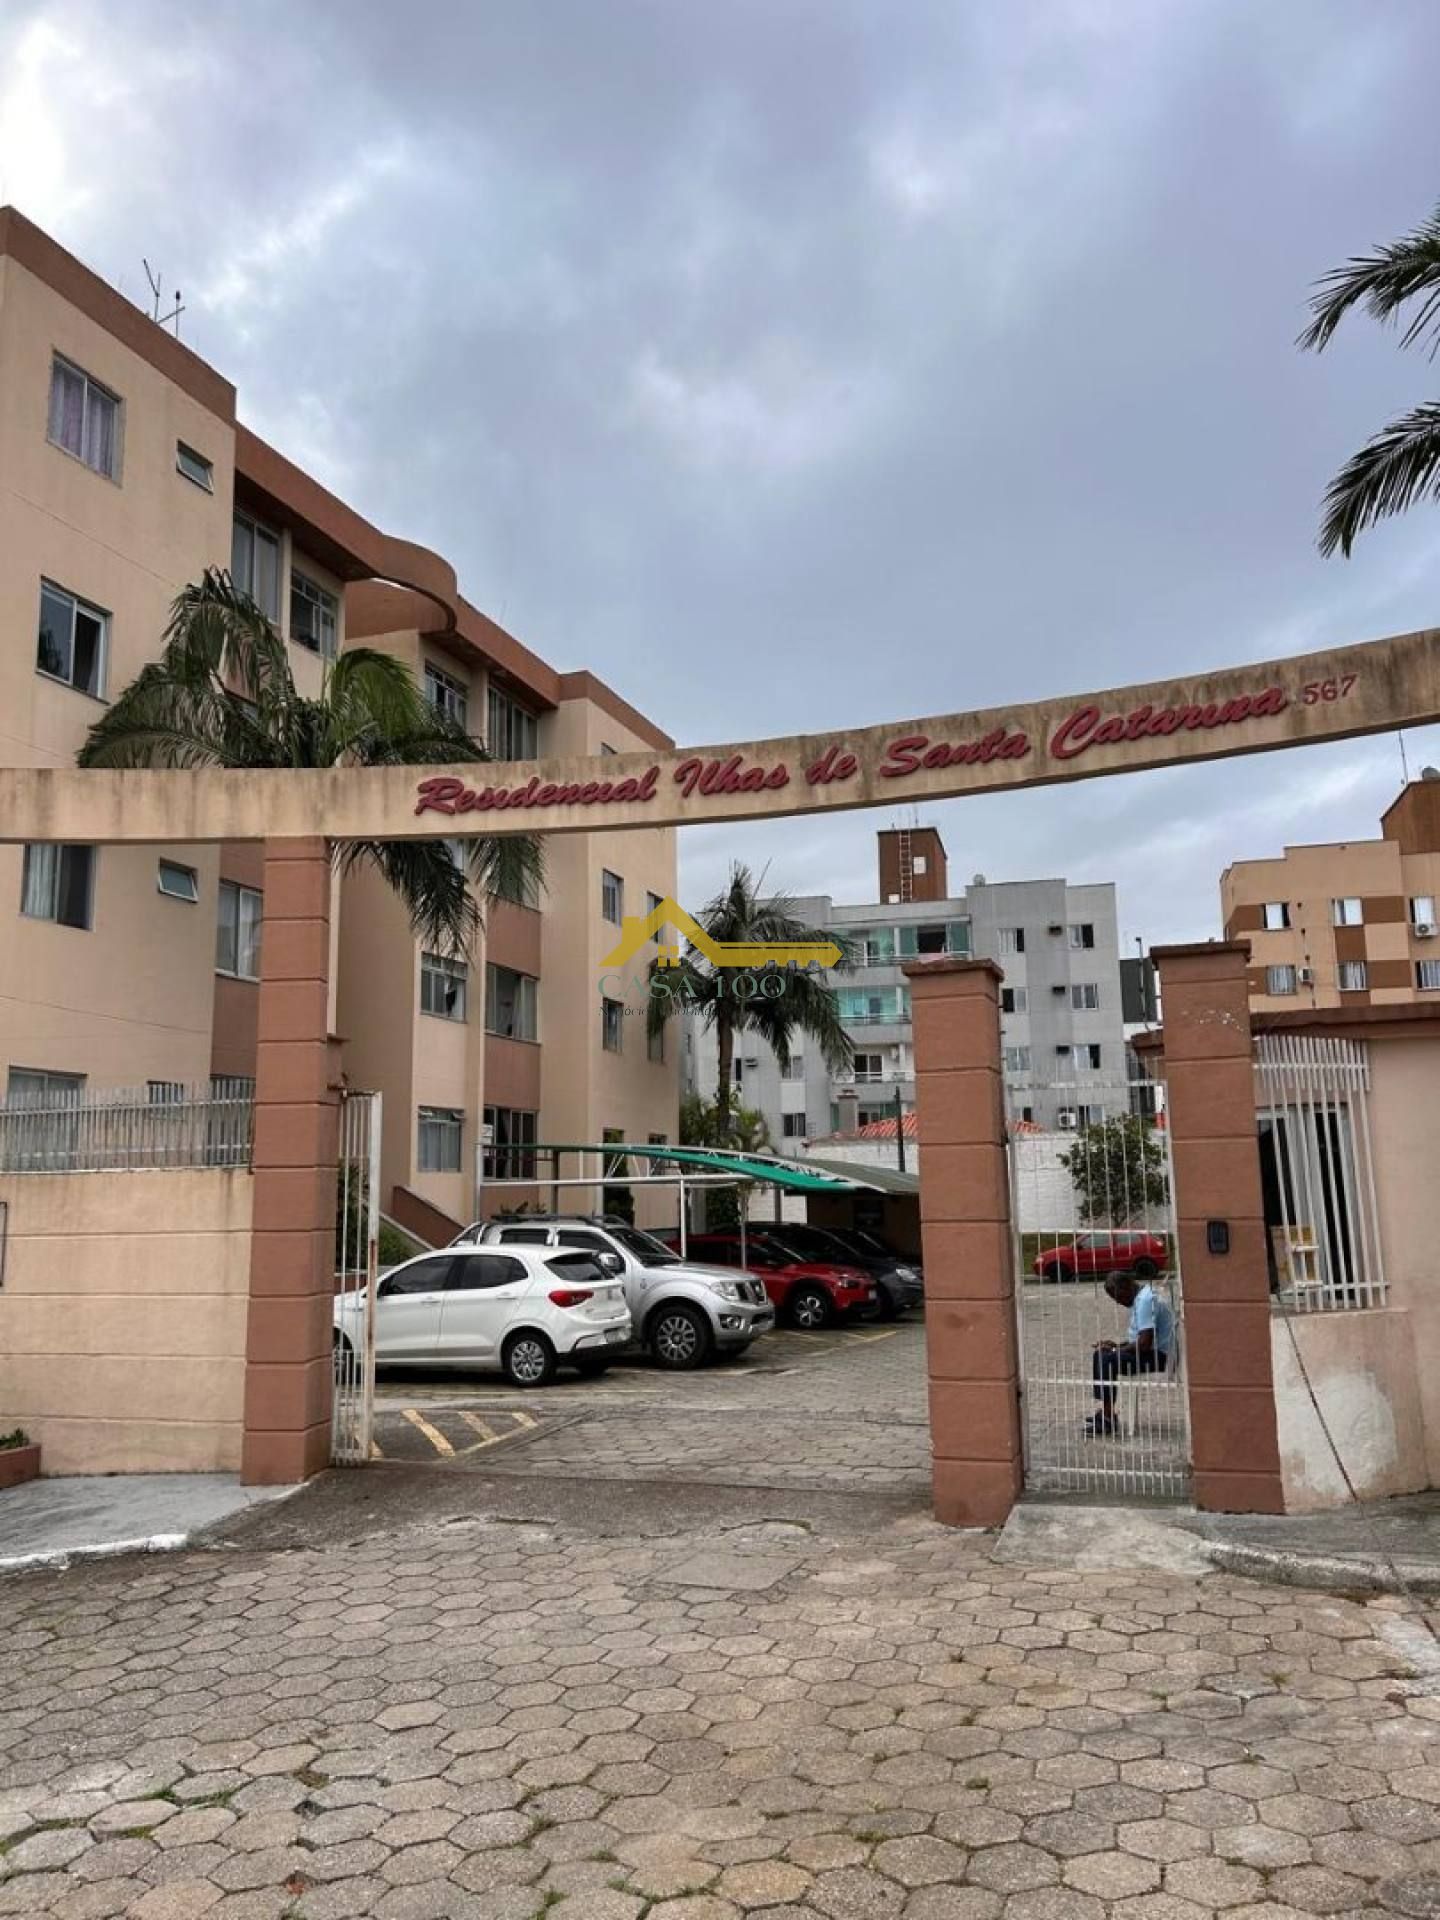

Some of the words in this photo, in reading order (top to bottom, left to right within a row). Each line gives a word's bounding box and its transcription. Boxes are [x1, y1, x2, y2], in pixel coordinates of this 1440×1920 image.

[414, 765, 660, 816] Residencial
[673, 755, 790, 798] Ilhas
[805, 745, 858, 785] de
[879, 728, 1031, 778] Santa
[1050, 687, 1288, 759] Catarina
[1303, 675, 1356, 705] 567
